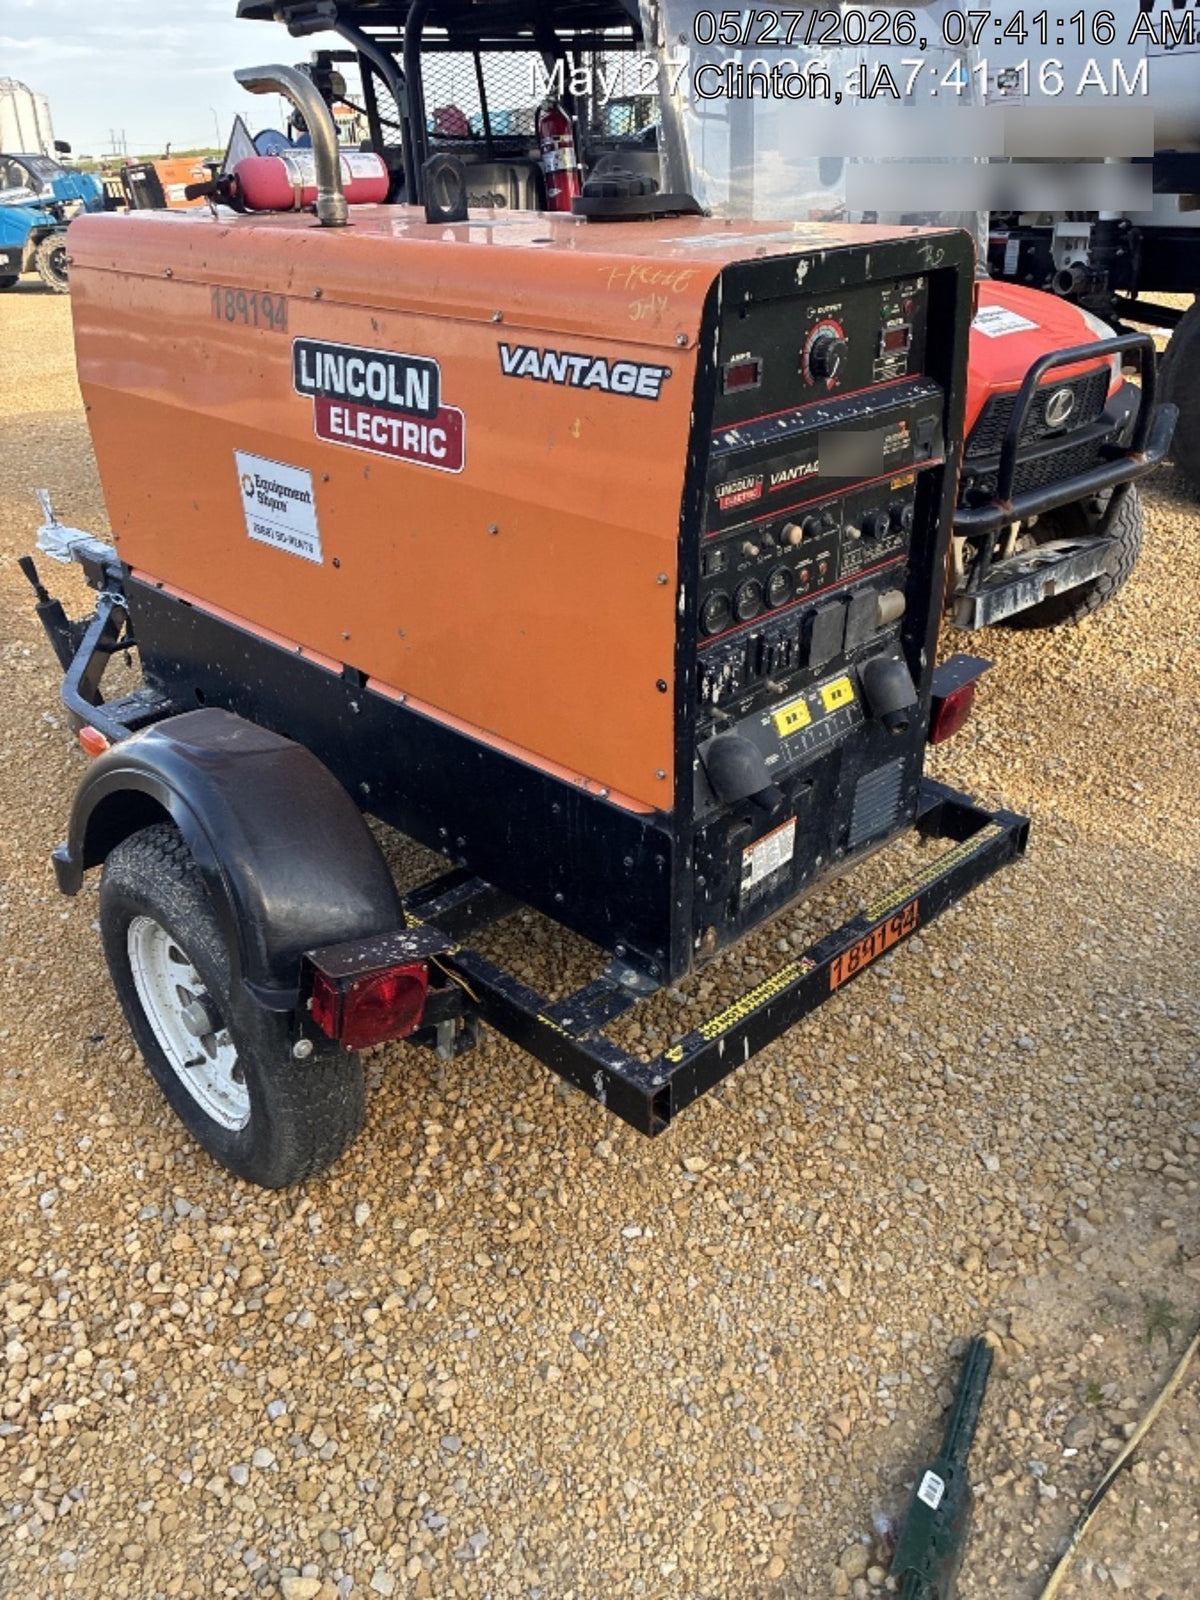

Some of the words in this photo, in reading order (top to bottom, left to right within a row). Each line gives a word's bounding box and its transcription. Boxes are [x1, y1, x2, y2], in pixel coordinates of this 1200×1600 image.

[211, 287, 288, 332] 189194
[299, 348, 430, 412] LINCOLN
[499, 343, 664, 399] VANTAGE
[329, 405, 447, 459] ELECTRIC
[833, 902, 915, 982] 189194
